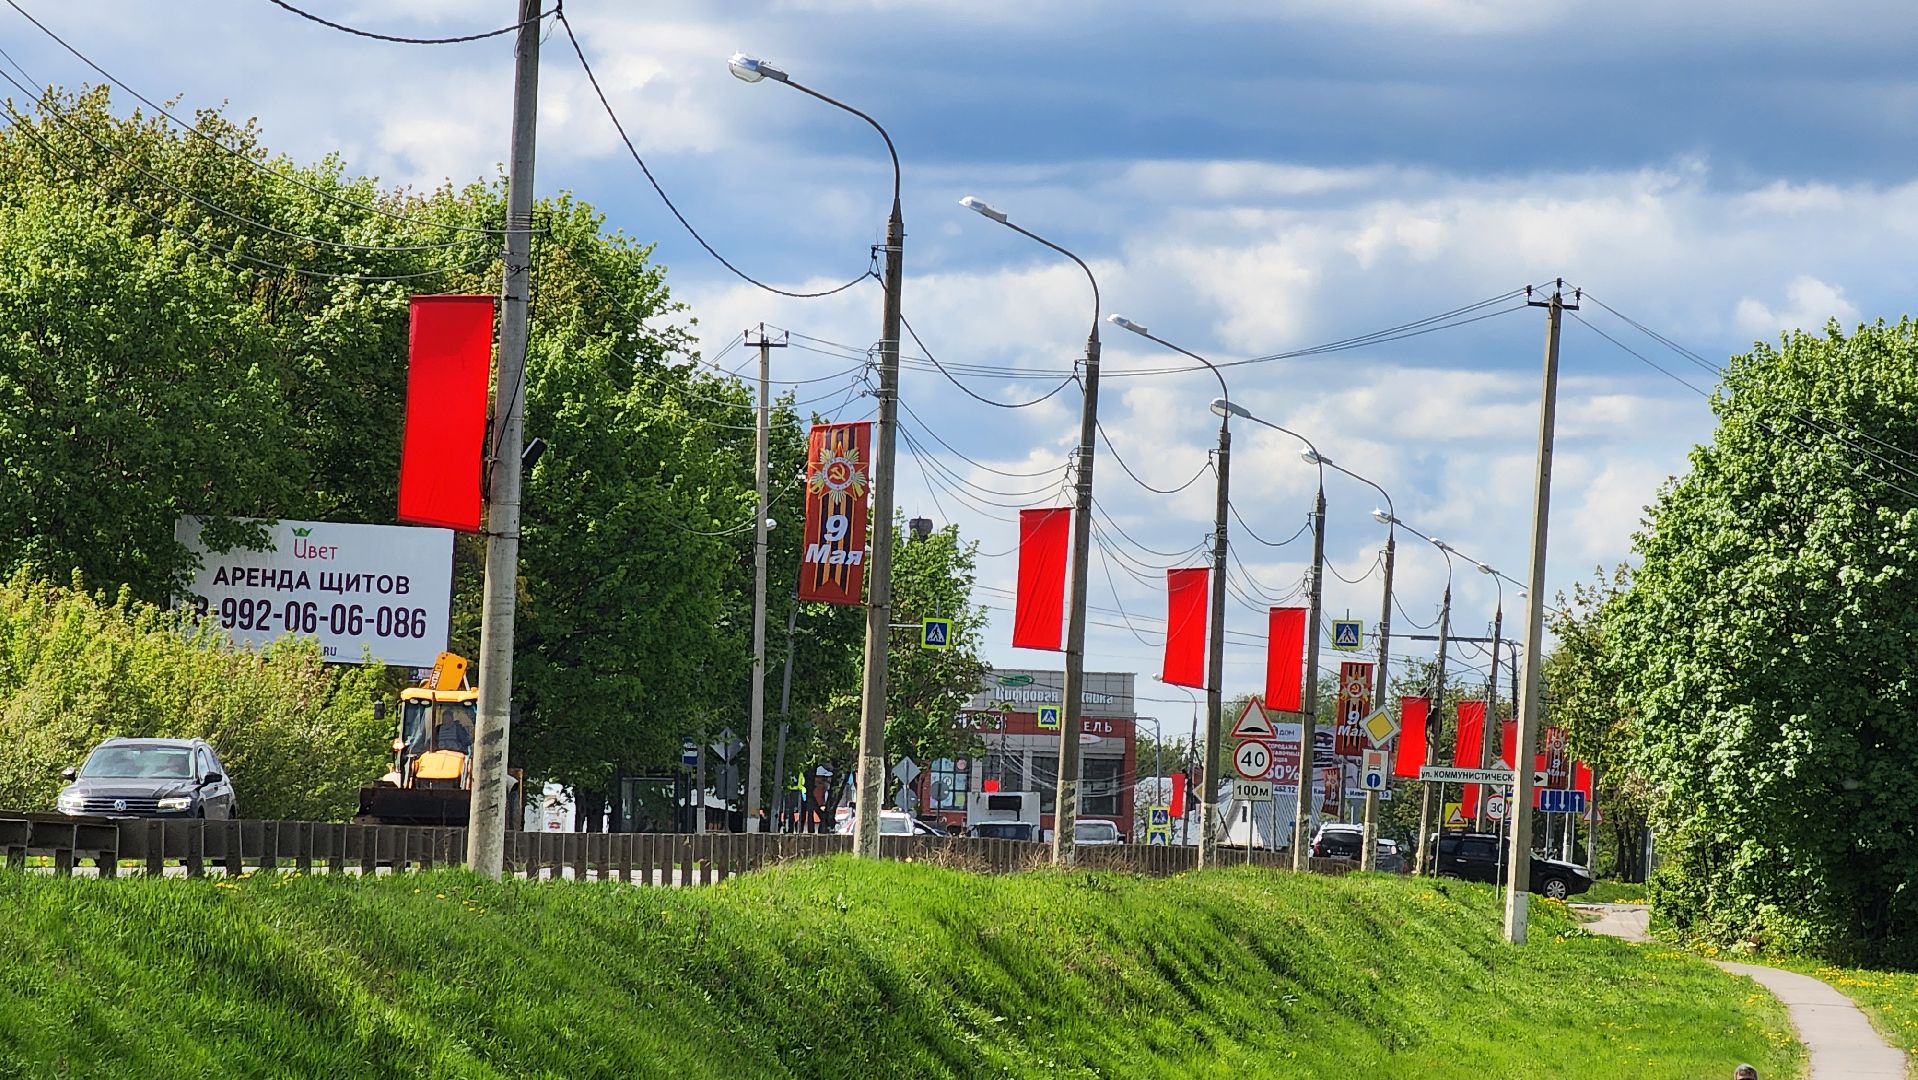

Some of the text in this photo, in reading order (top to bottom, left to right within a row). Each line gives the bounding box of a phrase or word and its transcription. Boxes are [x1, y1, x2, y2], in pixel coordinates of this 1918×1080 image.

[824, 514, 849, 542] 9
[805, 543, 863, 566] Мая
[213, 566, 410, 595] АРЕНДА ЩИТОВ
[1347, 711, 1360, 725] 9
[1240, 751, 1265, 767] 40
[1421, 770, 1515, 782] ул. КОММУНИСТИЧЕСК
[1490, 803, 1503, 813] 30
